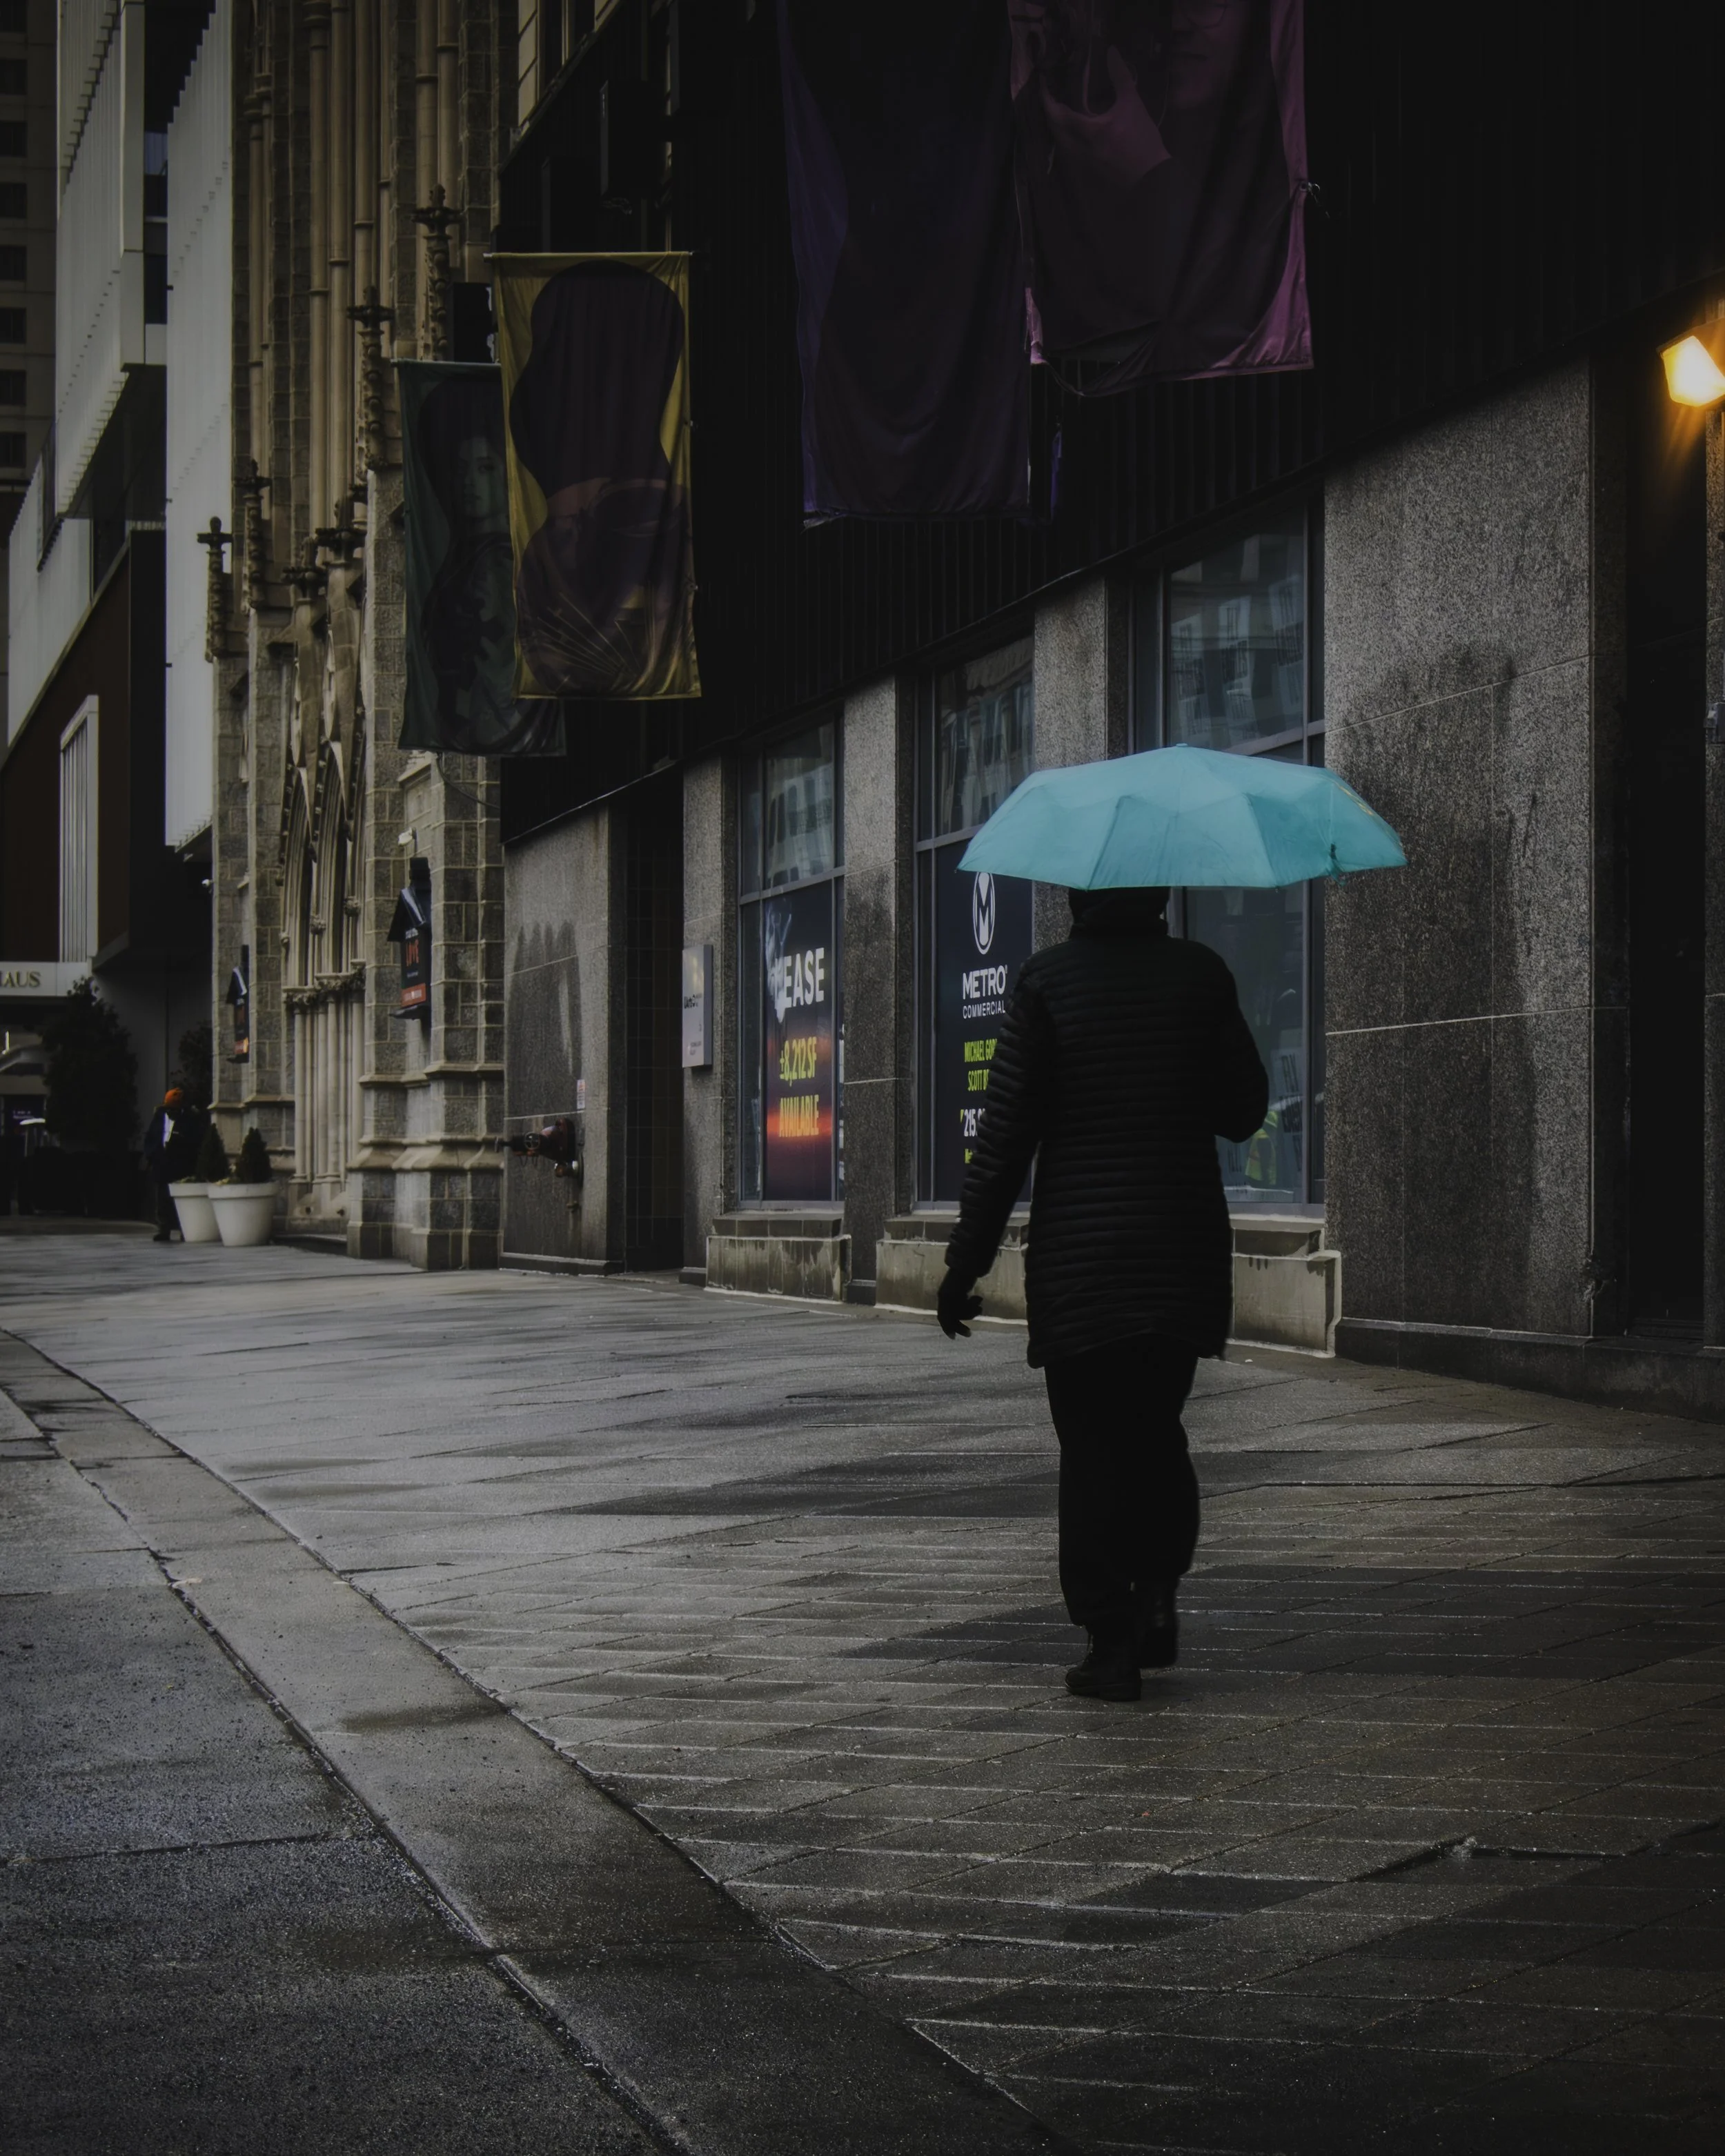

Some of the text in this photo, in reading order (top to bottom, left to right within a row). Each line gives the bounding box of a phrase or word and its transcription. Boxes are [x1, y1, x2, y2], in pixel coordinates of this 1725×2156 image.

[0, 971, 41, 989] AUS
[963, 965, 1006, 1000] METRO
[963, 1000, 1006, 1019] COMMERCIAL
[807, 1036, 817, 1078] SF
[964, 1040, 985, 1062] MICHAEL
[967, 1069, 983, 1091] SCOTT
[779, 1094, 820, 1137] AVAILABLE
